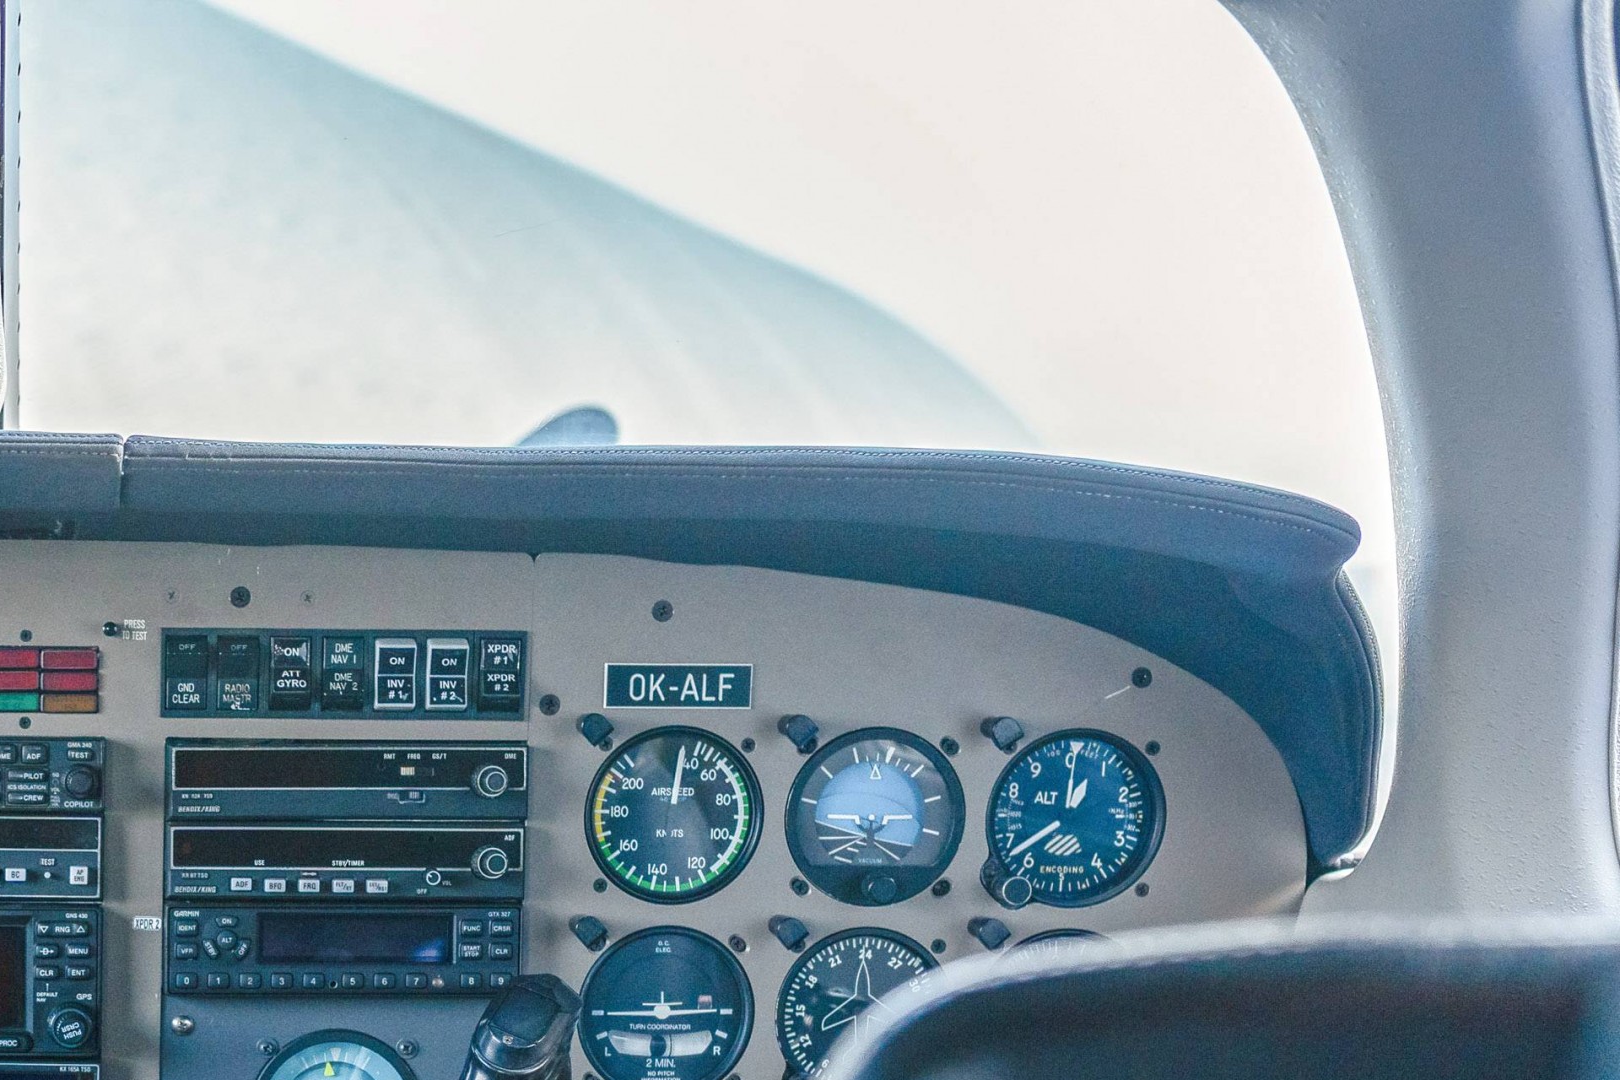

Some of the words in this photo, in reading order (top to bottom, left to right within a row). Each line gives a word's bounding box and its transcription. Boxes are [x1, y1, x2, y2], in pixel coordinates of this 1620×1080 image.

[284, 647, 299, 657] ON
[335, 643, 353, 653] DME
[487, 643, 515, 654] XPDR
[331, 653, 349, 663] NAV
[353, 653, 356, 663] 1
[389, 657, 405, 665] ON
[441, 658, 457, 667] ON
[281, 670, 301, 678] ATT
[334, 673, 352, 682] DME
[486, 673, 515, 682] XPDR
[177, 683, 195, 693] GND
[276, 678, 307, 689] GYRO
[329, 681, 348, 690] NAV
[351, 681, 358, 690] 2
[387, 679, 404, 689] INV
[439, 680, 457, 690] INV
[629, 674, 734, 702] OK-ALF
[224, 684, 250, 694] RADIO
[172, 693, 200, 704] CLEAR
[222, 694, 252, 704] MASTR
[700, 768, 716, 781] 60
[622, 778, 644, 790] 200
[716, 794, 731, 806] 80
[1034, 792, 1057, 804] ALT
[610, 806, 628, 818] 180
[710, 828, 730, 840] 100
[619, 840, 638, 851] 160
[40, 858, 55, 866] TEST
[687, 857, 706, 869] 120
[648, 864, 667, 875] 140
[10, 871, 20, 879] BC
[54, 925, 70, 933] RNG
[134, 918, 153, 930] XPDR
[154, 918, 160, 930] 2
[68, 947, 88, 955] MENU
[71, 969, 86, 977] ENT
